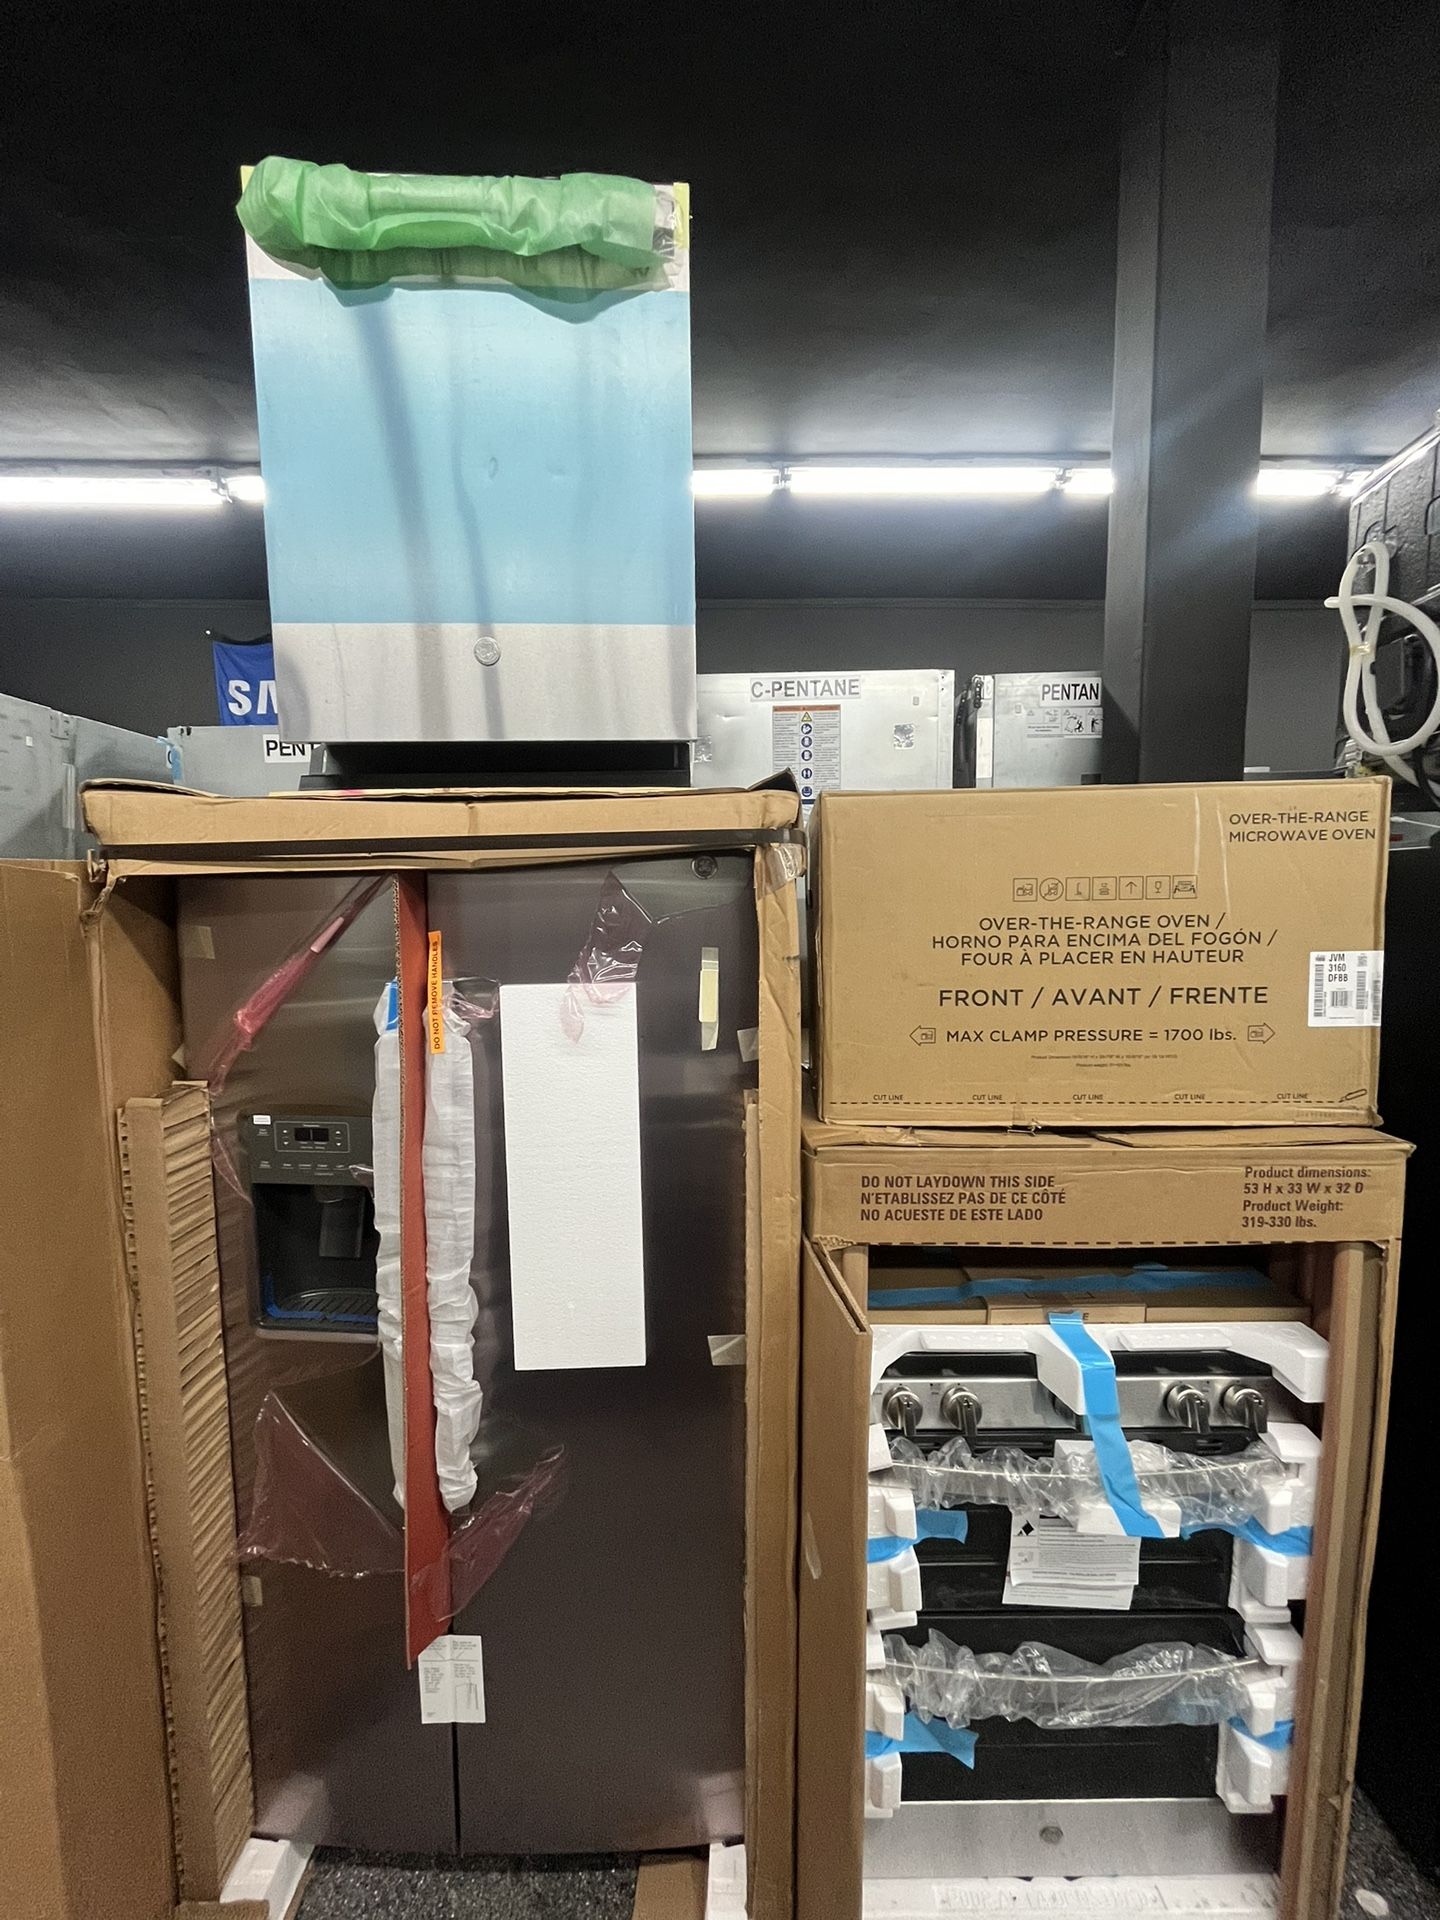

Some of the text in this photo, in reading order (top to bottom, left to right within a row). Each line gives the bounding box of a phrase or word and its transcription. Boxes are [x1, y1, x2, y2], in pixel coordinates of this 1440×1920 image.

[751, 679, 860, 698] C-PENTANE
[1042, 683, 1099, 700] PENTAN
[1229, 811, 1368, 825] OVER-THE-RANGE
[1229, 828, 1375, 842] MICROWAVE OVEN
[979, 912, 1226, 930] OVER-THE-RANGE OVEN /
[932, 928, 1278, 948] HORNO PARA ENCIMA DEL FOGÓN /
[962, 949, 1244, 966] FOUR À PLACER EN HAUTEUR
[1329, 953, 1345, 961] JVM
[1328, 963, 1346, 972] 3160
[939, 985, 1268, 1009] FRONT / AVANT / FRENTE
[947, 1028, 1236, 1042] MAX CLAMP PRESSURE = 1700 lbs.
[434, 1039, 440, 1050] DO
[1245, 1166, 1371, 1178] Product dimensions:
[861, 1175, 1055, 1188] DO NOT LAYDOWN THIS SIDE
[1244, 1182, 1364, 1194] 53 H x 33 W x 32 D
[958, 1192, 985, 1204] PAS
[990, 1192, 1006, 1204] DE
[1032, 1189, 1066, 1204] CÔTÉ
[1243, 1200, 1343, 1214] Product Weight:
[860, 1208, 1043, 1221] NO ACUESTE DE ESTE LADO
[1242, 1216, 1316, 1228] 319-330 lbs.
